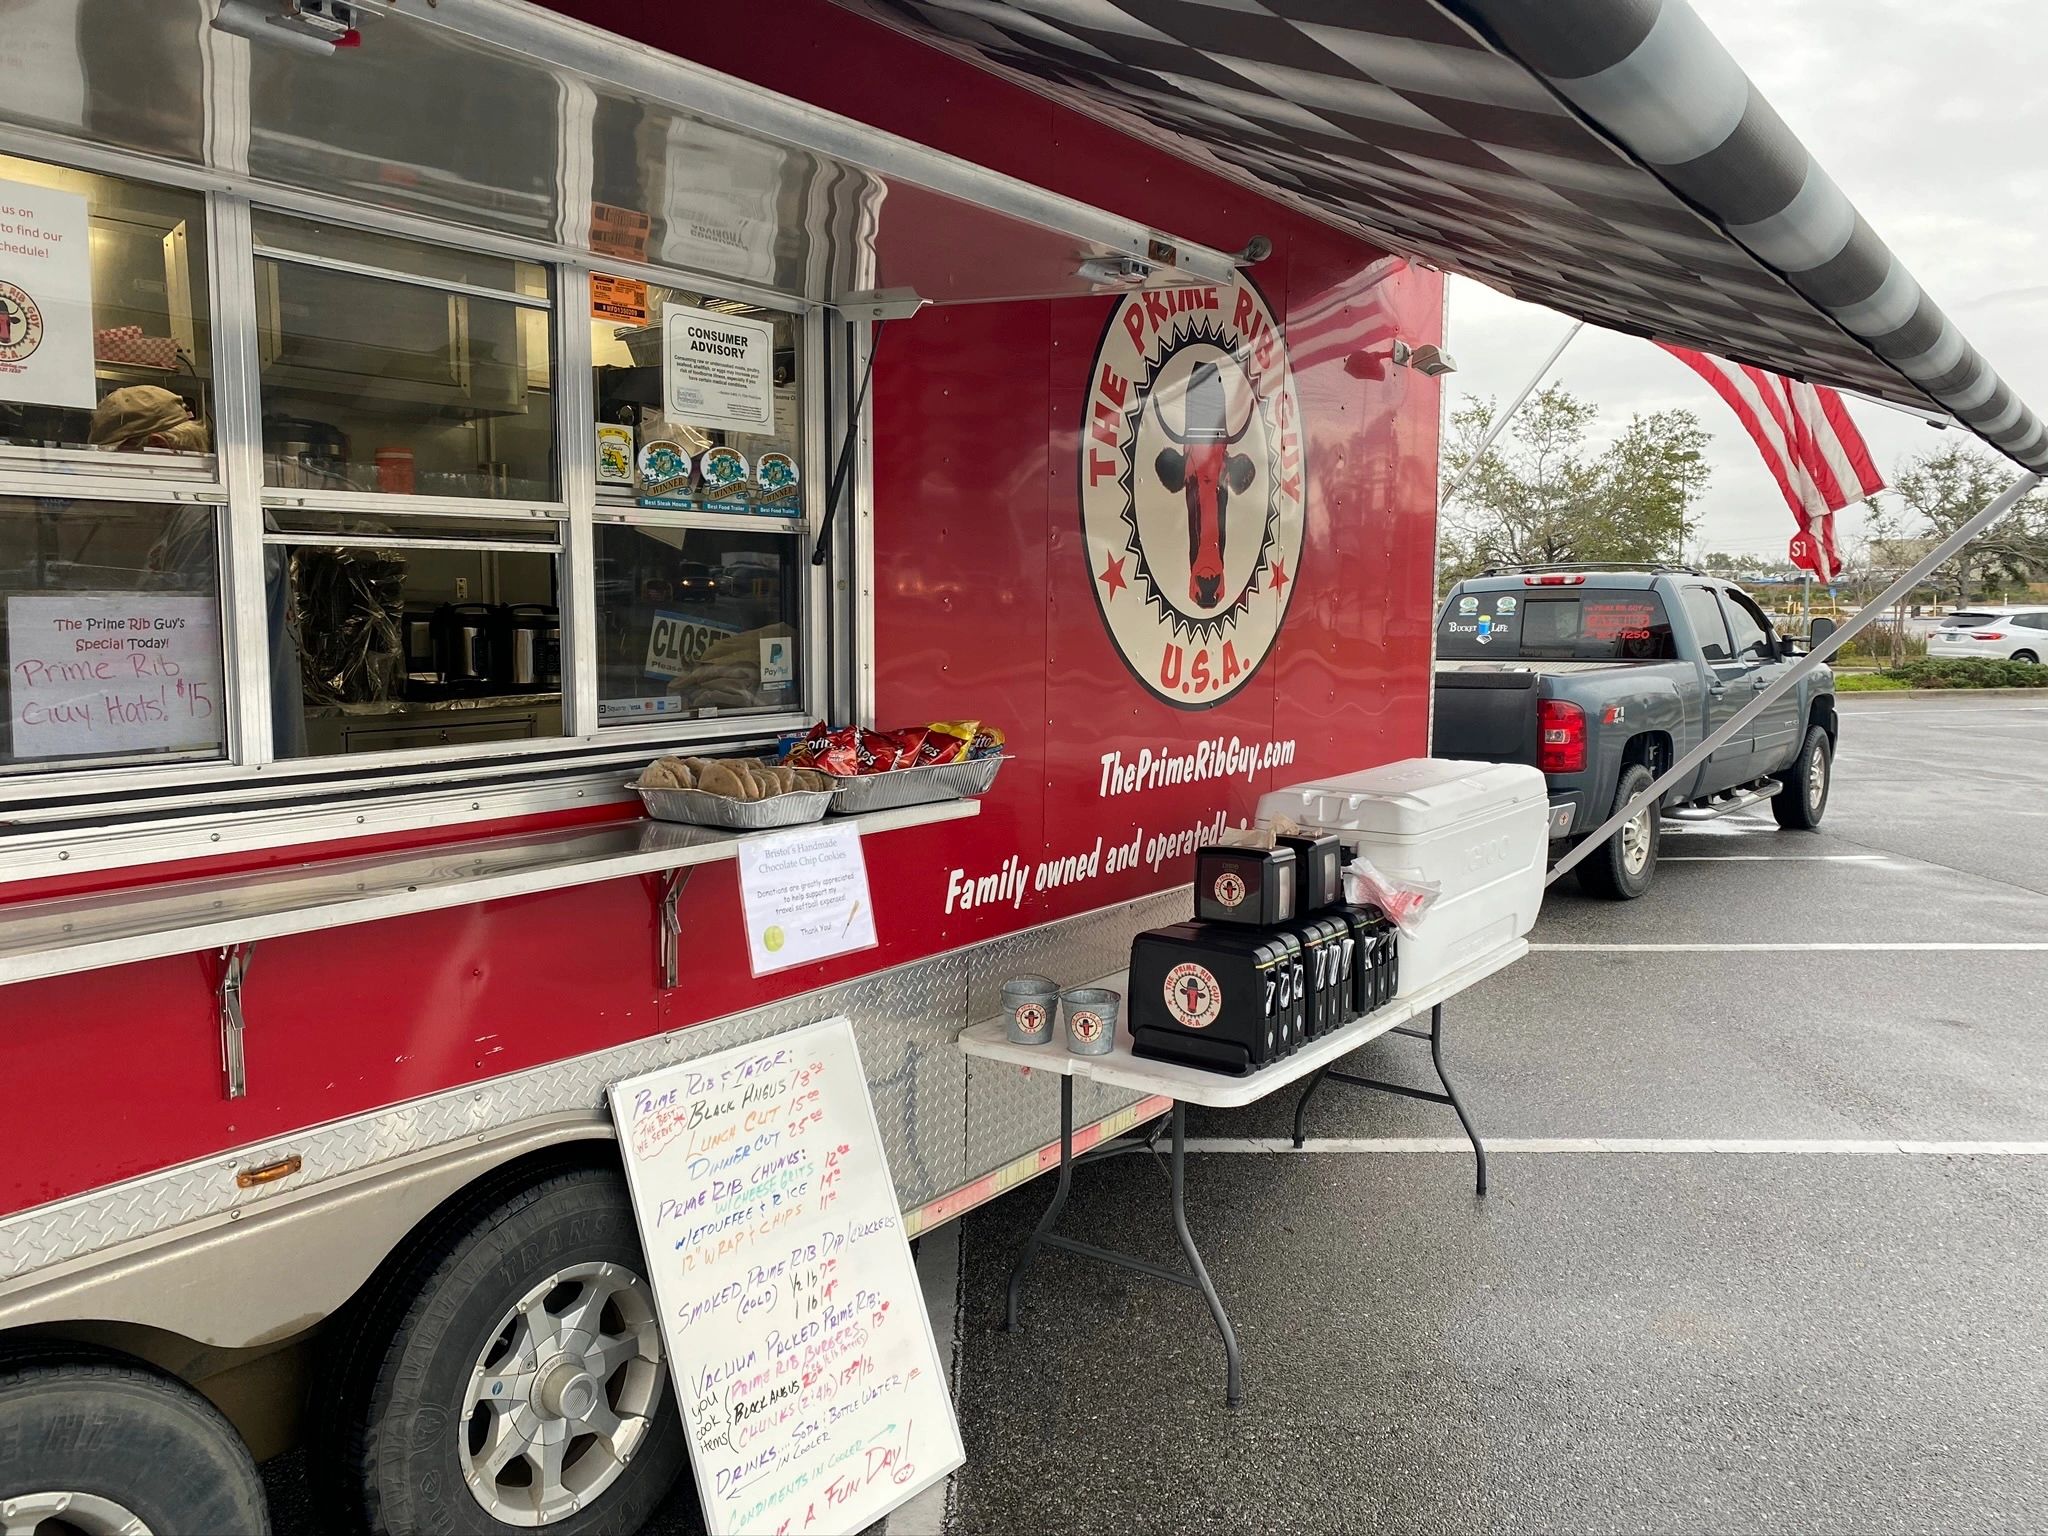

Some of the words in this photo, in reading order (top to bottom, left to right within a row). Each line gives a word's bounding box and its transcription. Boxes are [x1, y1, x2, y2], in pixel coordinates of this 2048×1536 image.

[1, 204, 16, 217] us
[18, 208, 34, 219] on
[0, 223, 14, 234] to
[17, 223, 40, 239] find
[44, 230, 63, 243] our
[9, 287, 26, 304] RIB
[27, 306, 40, 329] GUY
[687, 326, 748, 348] CONSUMER
[690, 340, 745, 361] ADVISORY
[1089, 363, 1129, 488] THE
[1232, 286, 1274, 370] RIB
[1274, 390, 1302, 505] GUY
[652, 478, 684, 495] WINNER
[713, 483, 743, 499] WINNER
[766, 487, 794, 502] WINNER
[1791, 541, 1807, 557] ST
[53, 618, 83, 632] The
[85, 617, 126, 632] Prime
[127, 617, 151, 631] Rib
[153, 617, 186, 632] Guy's
[75, 637, 125, 653] Special
[127, 637, 170, 650] Today!
[653, 619, 731, 663] CLOS
[15, 659, 116, 687] Prime
[126, 653, 181, 680] Rib
[764, 667, 789, 678] PayPal
[1160, 639, 1251, 695] U.S.A.
[22, 701, 95, 732] Guy
[105, 684, 169, 726] Hats!
[175, 677, 213, 720] $15
[607, 705, 627, 713] Square
[1099, 735, 1297, 798] ThePrimeRibGuy.com
[758, 859, 798, 874] Chocolate
[799, 855, 818, 867] Chip
[818, 850, 847, 863] Cookies
[764, 844, 796, 859] Bristol's
[797, 838, 838, 854] Handmade
[757, 886, 788, 899] Donations
[788, 884, 800, 892] are
[800, 879, 821, 892] greatly
[822, 872, 855, 888] appreciated
[944, 854, 1030, 915] Family
[1034, 835, 1103, 892] owned
[1105, 827, 1143, 875] and
[775, 903, 795, 915] travel
[795, 900, 819, 912] softball
[783, 895, 791, 903] to
[791, 892, 805, 902] help
[805, 889, 828, 901] support
[828, 886, 837, 896] my
[800, 926, 819, 937] Thank
[819, 923, 832, 932] You!
[1165, 975, 1175, 991] THE
[1173, 964, 1197, 976] PRIME
[1200, 968, 1213, 982] RIB
[1211, 985, 1220, 1005] GUY
[632, 1088, 678, 1120] PRIME
[685, 1072, 715, 1099] RIB
[686, 1099, 736, 1131] BLACK
[741, 1079, 787, 1109] ANGUS
[639, 1121, 656, 1137] THE
[656, 1109, 676, 1126] BEST
[685, 1125, 736, 1163] LUNCH
[744, 1105, 781, 1133] CUT
[637, 1141, 649, 1154] WE
[651, 1124, 673, 1145] SERVE
[688, 1144, 751, 1182] DINNER
[754, 1131, 781, 1152] CUT
[656, 1190, 708, 1228] PRIME
[711, 1178, 744, 1203] RIB
[751, 1148, 807, 1185] CHUNKS:
[780, 1162, 816, 1190] GRITS
[703, 1231, 745, 1266] WRAP
[758, 1203, 803, 1234] CHIPS
[677, 1281, 743, 1335] SMOKED
[747, 1260, 787, 1294] PRIME
[790, 1244, 817, 1268] RIB
[736, 1283, 778, 1325] (COLD)
[691, 1350, 757, 1400] VACUUM
[765, 1320, 820, 1361] PACKED
[822, 1303, 855, 1333] PRIME
[731, 1368, 771, 1400] PRIME
[775, 1353, 800, 1377] RIB
[804, 1321, 861, 1364] BURGERS
[769, 1379, 801, 1406] ANGUS
[691, 1391, 719, 1425] you
[828, 1400, 860, 1424] BOTTLE
[695, 1414, 721, 1441] cook
[700, 1431, 729, 1455] items
[776, 1453, 790, 1473] IN
[793, 1431, 831, 1460] COOLER
[803, 1502, 817, 1530] A
[824, 1474, 861, 1510] FUN
[865, 1419, 914, 1486] DAY!
[811, 1461, 825, 1481] IN
[827, 1439, 866, 1469] COOLER
